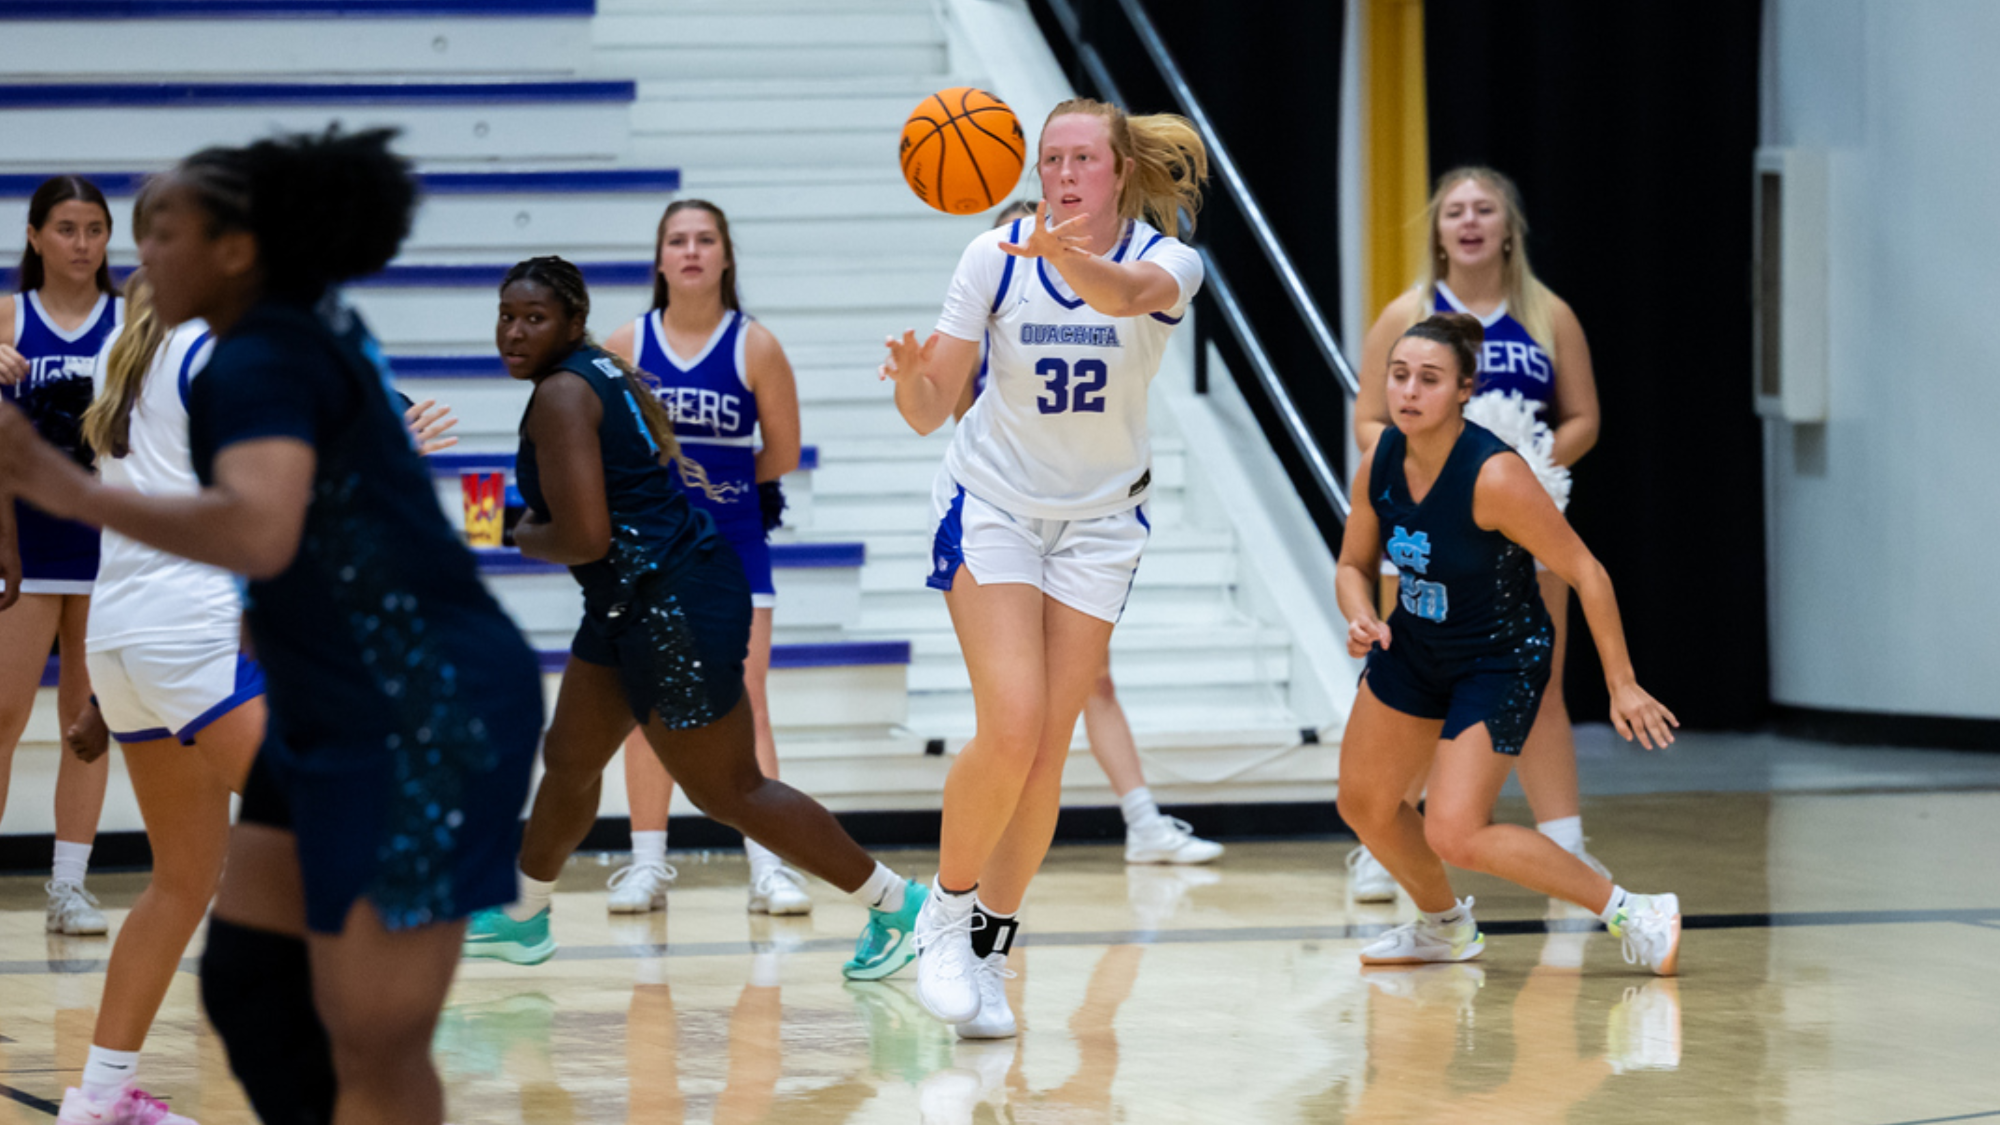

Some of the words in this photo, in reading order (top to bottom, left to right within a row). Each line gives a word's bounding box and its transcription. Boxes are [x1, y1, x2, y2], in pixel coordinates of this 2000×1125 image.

[1020, 323, 1120, 347] OUACHITA
[1476, 341, 1549, 383] ERS
[1035, 357, 1108, 414] 32
